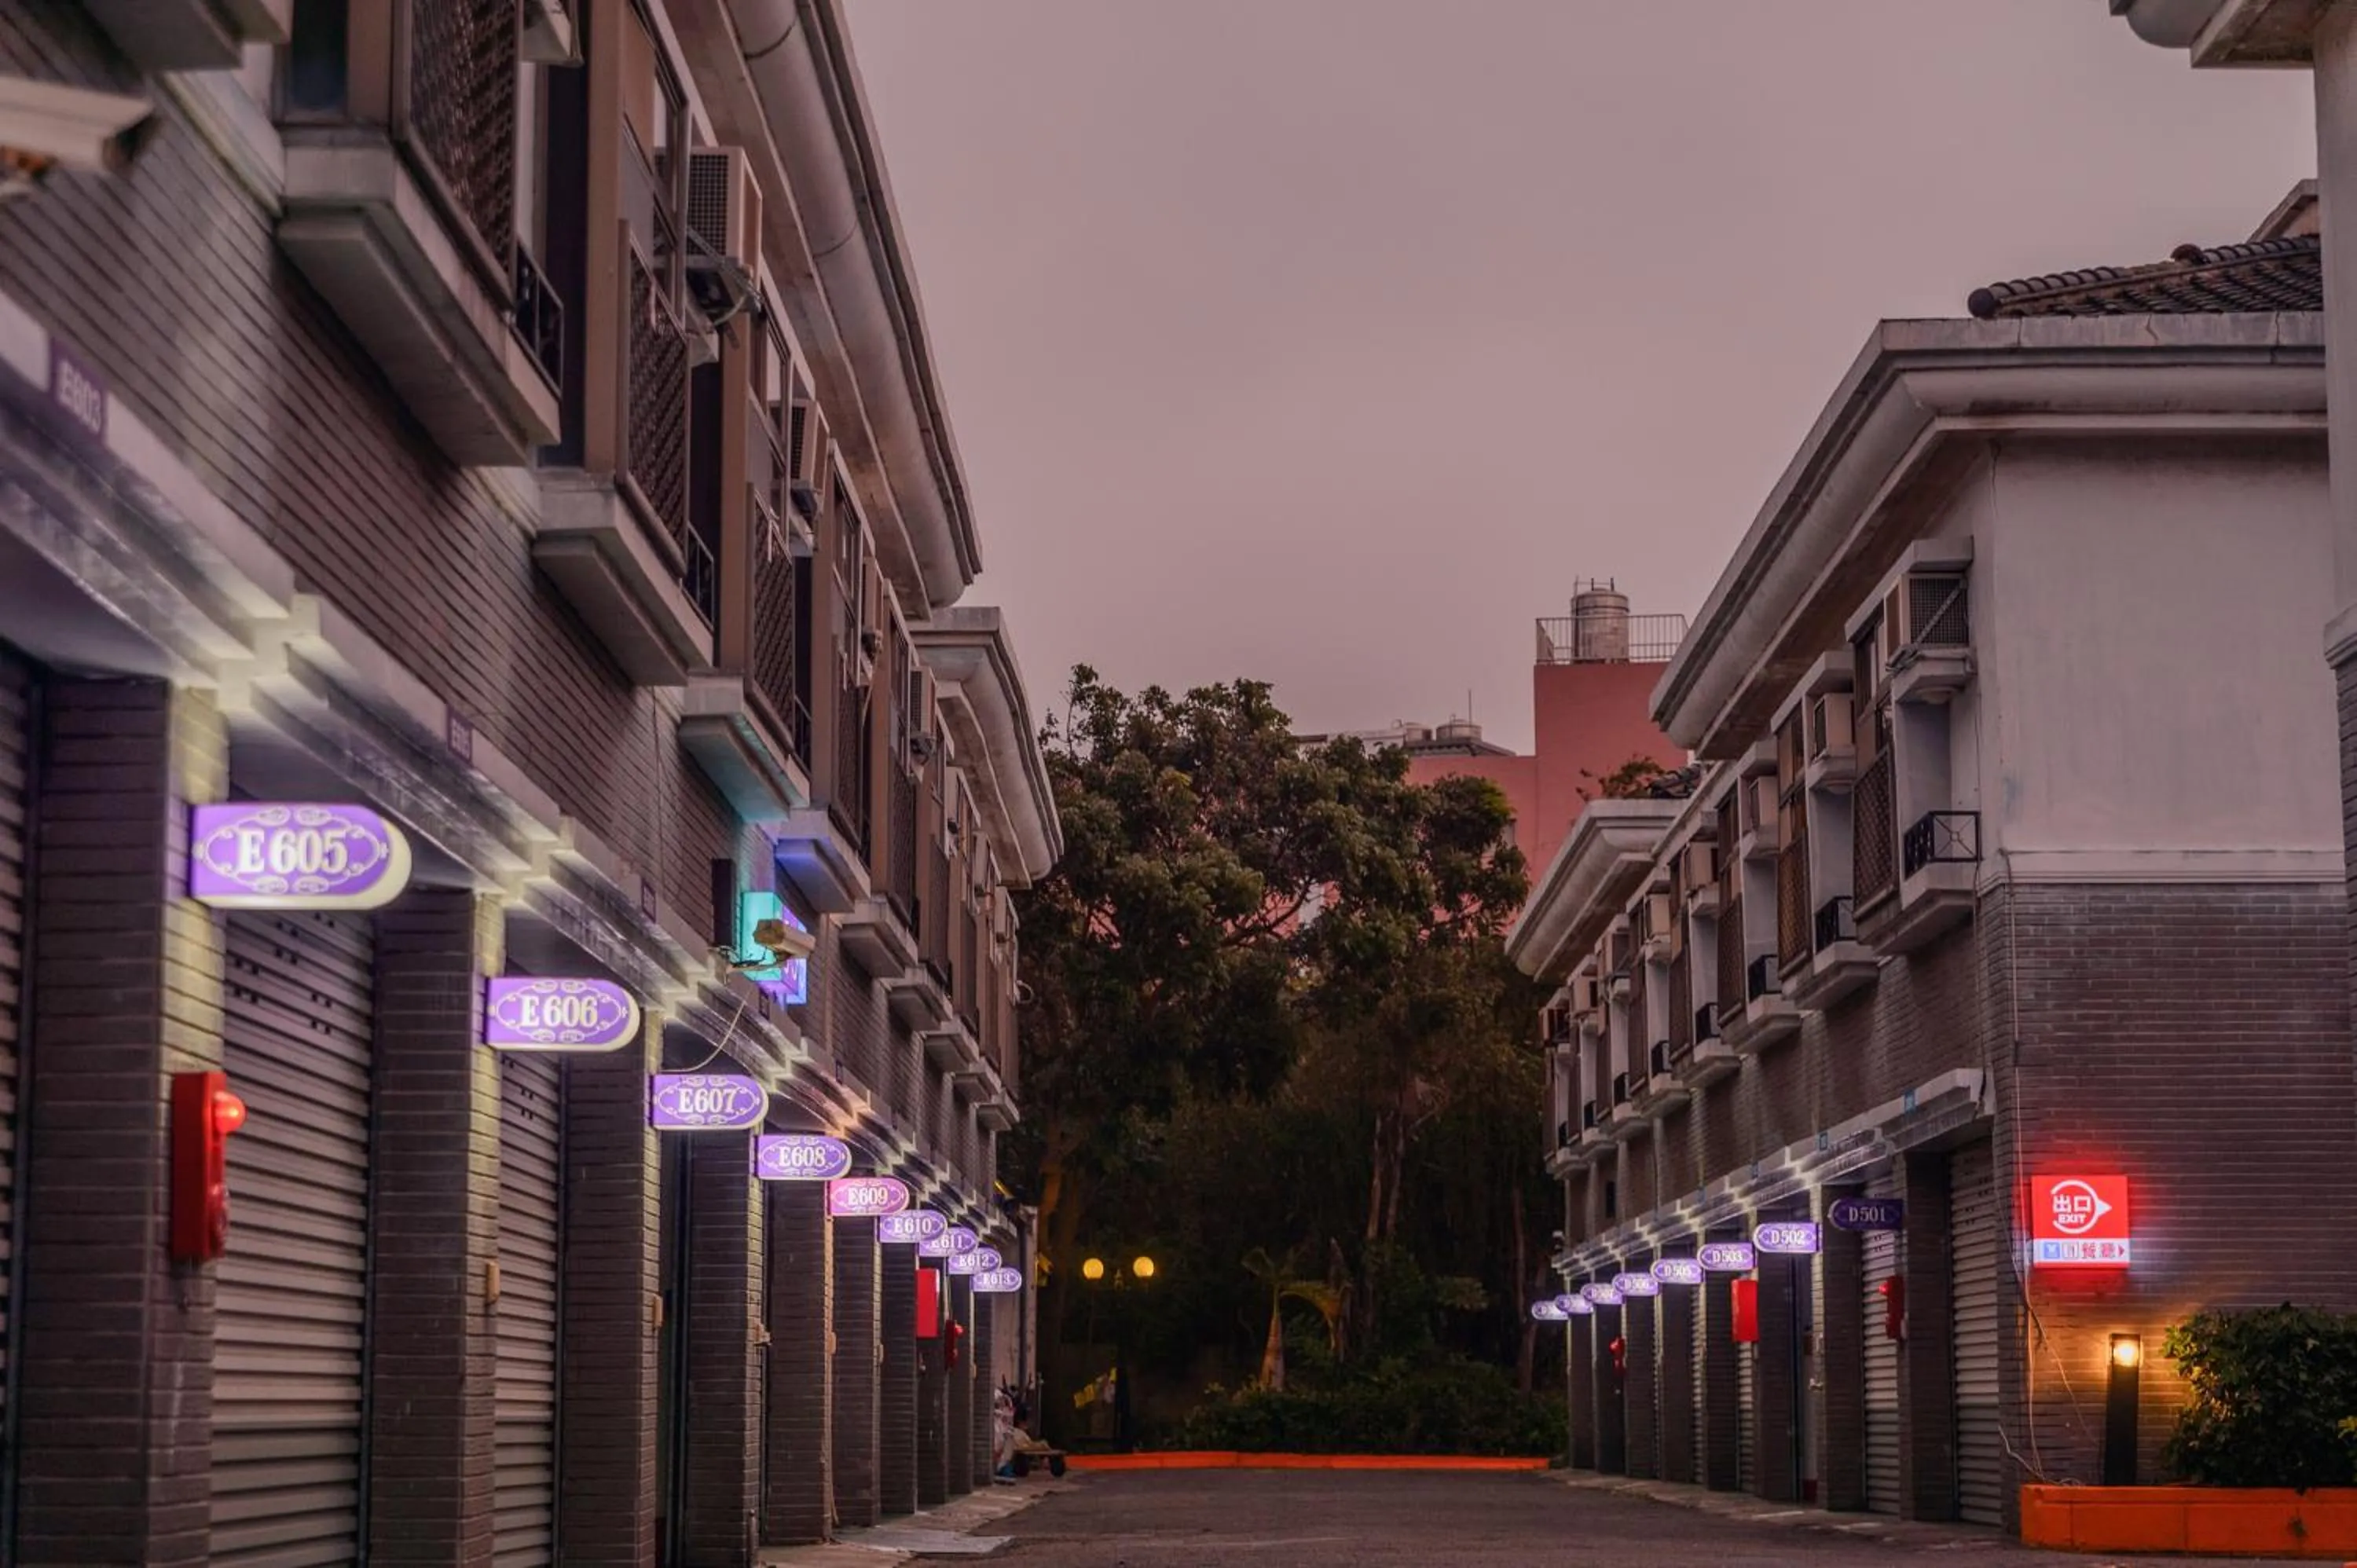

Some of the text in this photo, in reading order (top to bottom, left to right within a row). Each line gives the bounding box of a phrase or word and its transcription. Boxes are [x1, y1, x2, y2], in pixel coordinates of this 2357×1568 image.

[238, 827, 348, 875] E605
[521, 995, 598, 1028] E606
[678, 1087, 737, 1114] E607
[779, 1145, 826, 1167] E608
[848, 1186, 889, 1206] E609
[2052, 1194, 2091, 1213] 出口
[1848, 1206, 1886, 1222] D501
[2058, 1214, 2086, 1224] EXIT
[893, 1217, 933, 1235] E610
[1771, 1229, 1805, 1245] D502
[959, 1252, 989, 1267] E612
[1712, 1250, 1743, 1263] D503
